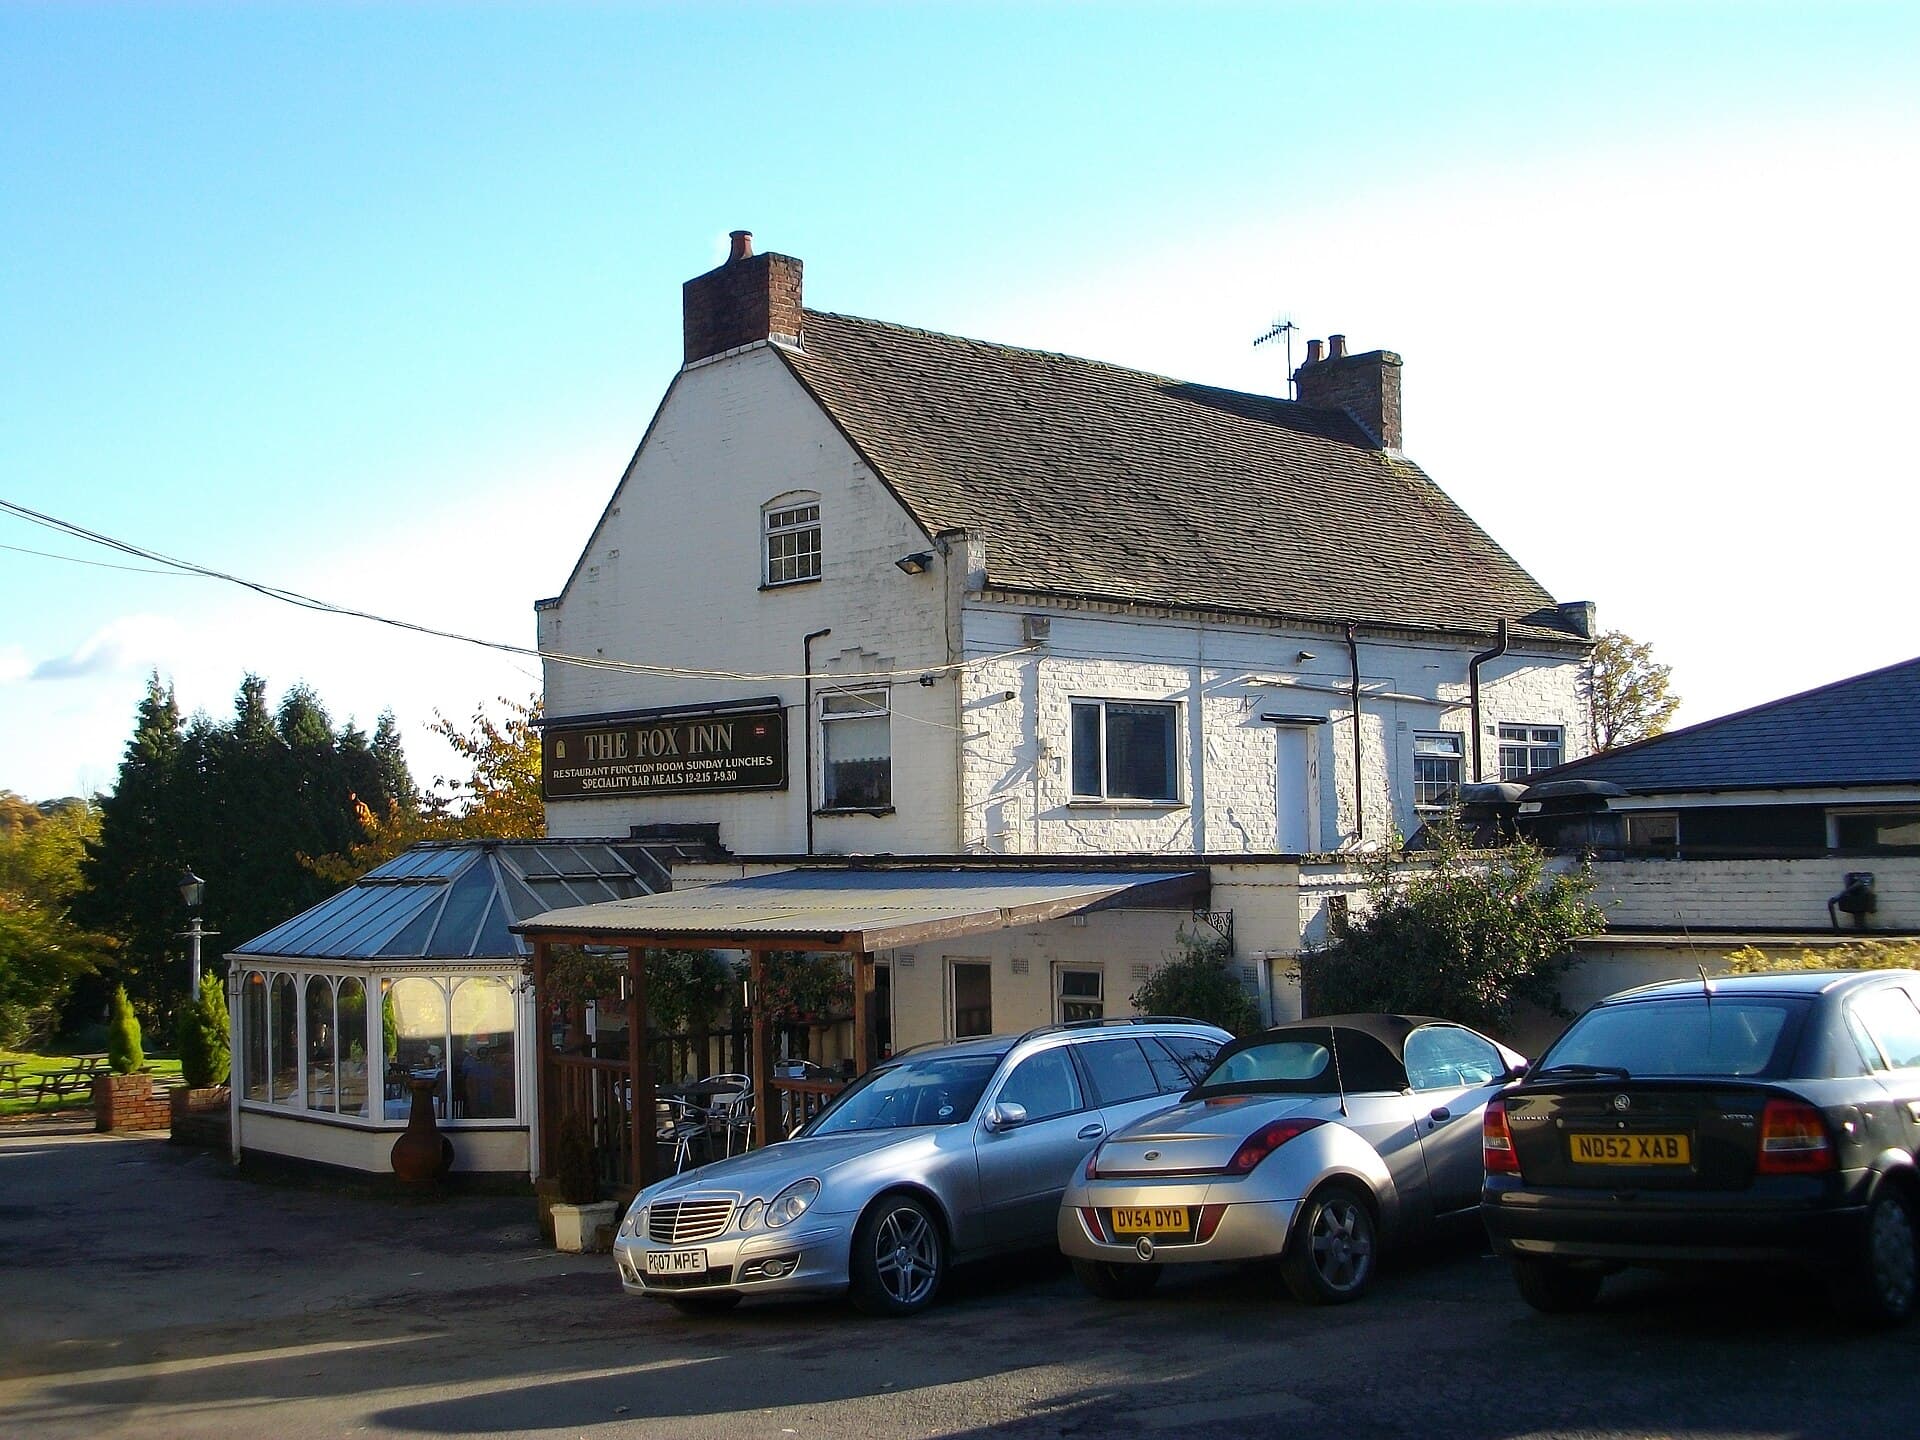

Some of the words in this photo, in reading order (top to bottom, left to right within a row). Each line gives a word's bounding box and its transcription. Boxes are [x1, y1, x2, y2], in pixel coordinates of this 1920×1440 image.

[584, 731, 629, 761] THE
[636, 727, 681, 758] FOX
[687, 723, 735, 755] INN
[553, 766, 609, 779] RESTAURANT
[610, 763, 655, 775] FUNCTION
[656, 761, 685, 773] ROOM
[686, 758, 724, 771] SUNDAY
[725, 755, 774, 768] LUNCHES
[582, 776, 631, 790] SPECIALITY
[631, 775, 650, 787] BAR
[651, 772, 684, 786] MEALS
[685, 770, 711, 784] 12-2.15
[713, 769, 738, 782] 7-9.30
[1580, 1137, 1632, 1158] ND52
[1637, 1138, 1680, 1159] XAB
[1117, 1209, 1151, 1228] DV54
[1155, 1209, 1183, 1227] DYD
[673, 1251, 701, 1270] MPE
